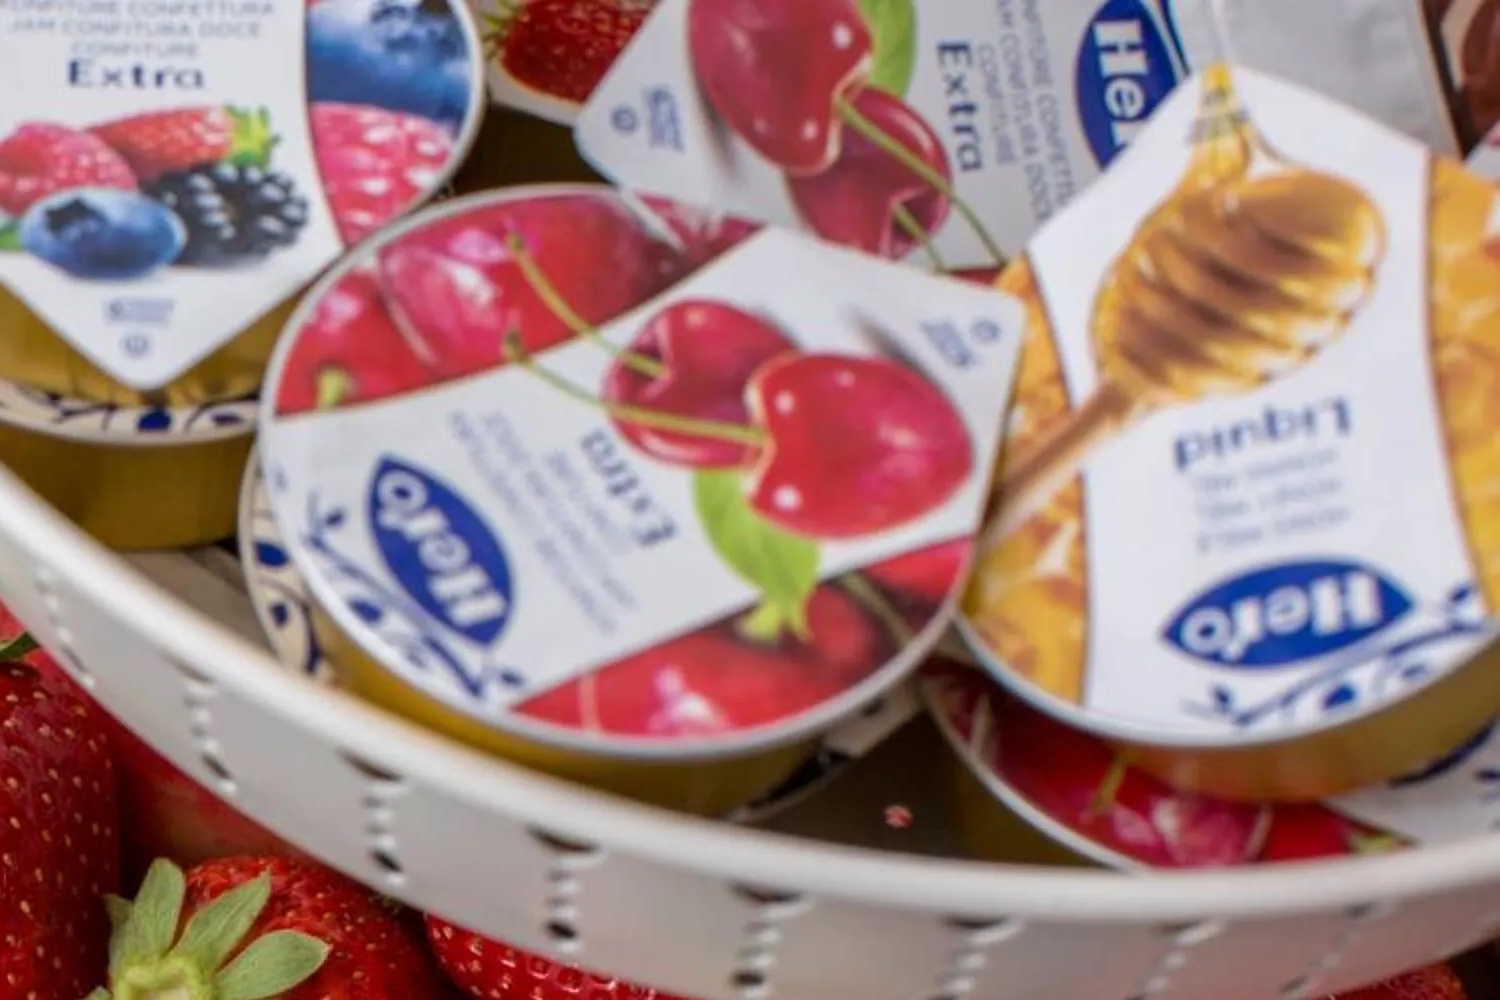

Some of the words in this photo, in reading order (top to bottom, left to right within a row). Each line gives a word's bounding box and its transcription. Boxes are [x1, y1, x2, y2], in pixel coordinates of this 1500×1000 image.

[68, 57, 205, 89] Extra
[936, 40, 984, 173] Extra
[1174, 396, 1351, 472] Liquid
[580, 429, 676, 547] Extra
[375, 469, 505, 628] Hero
[1180, 571, 1383, 662] Hero
